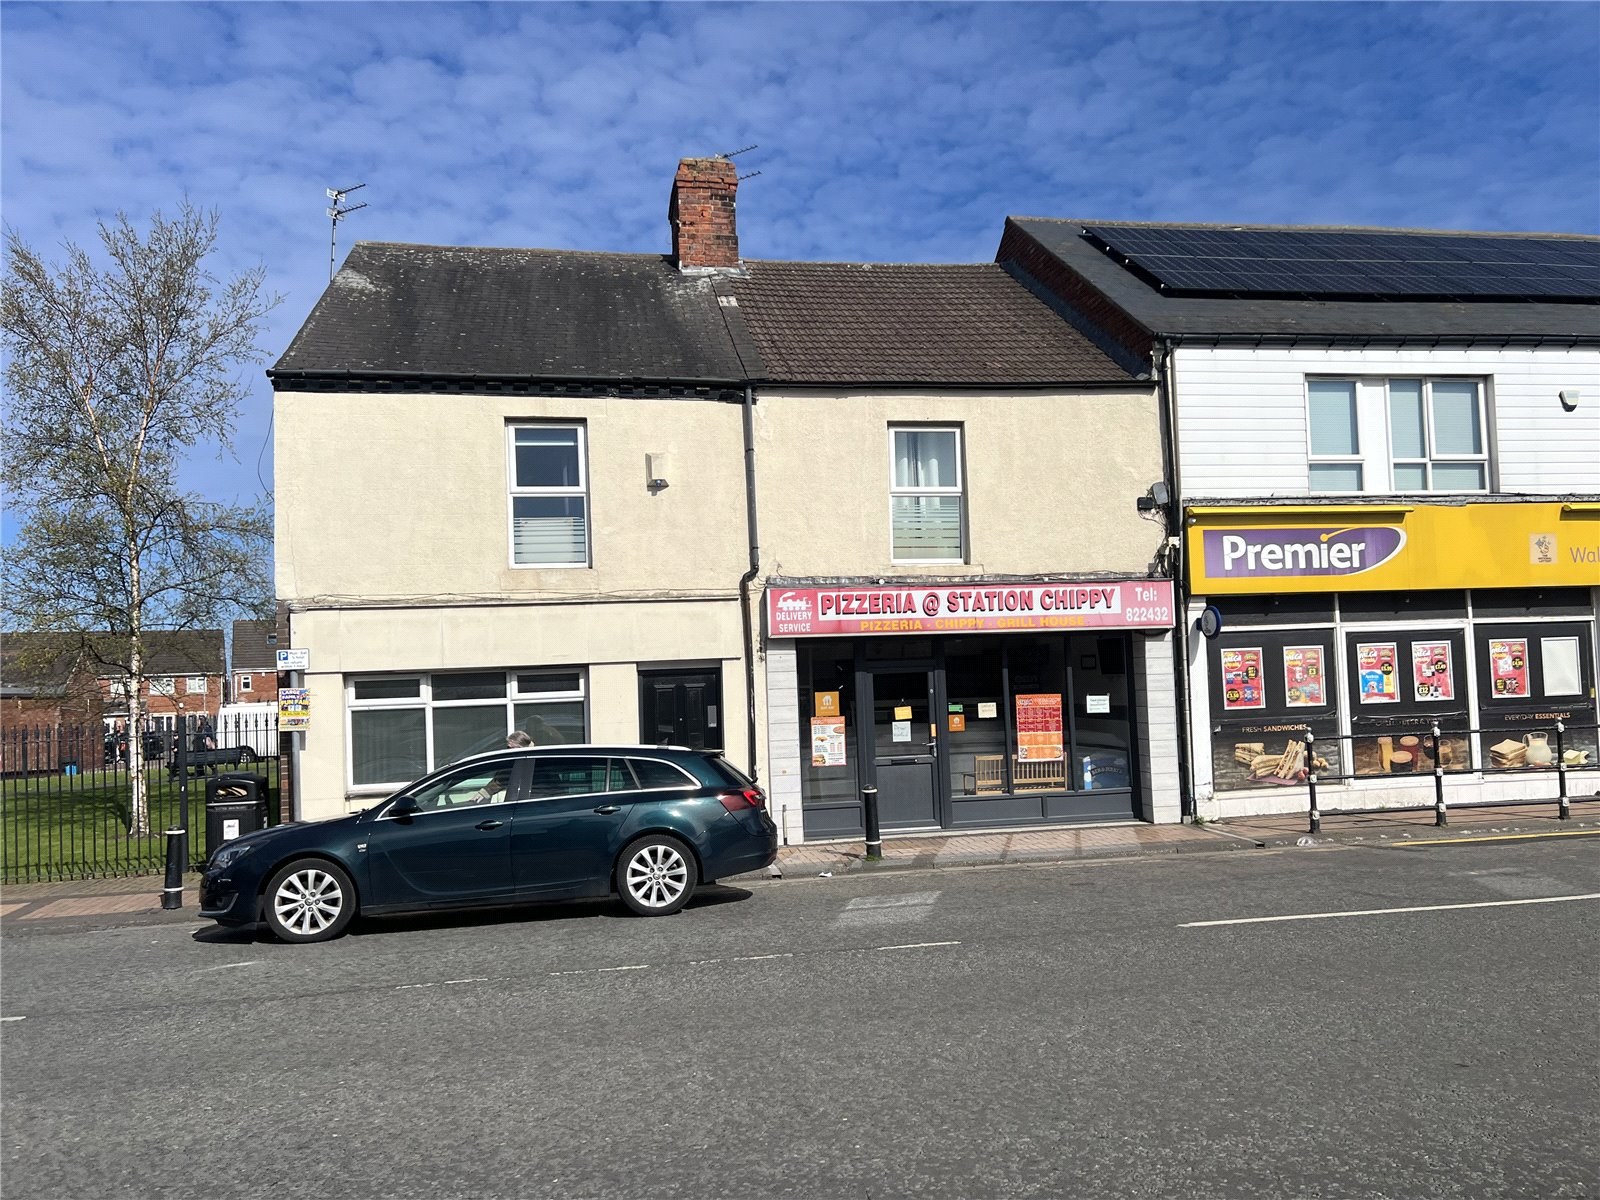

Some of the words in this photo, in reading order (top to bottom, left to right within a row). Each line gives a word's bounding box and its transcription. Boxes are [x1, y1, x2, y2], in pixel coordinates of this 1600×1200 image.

[1223, 534, 1366, 571] Premier
[821, 592, 916, 615] PIZZERIA
[923, 592, 941, 616] @
[947, 589, 1034, 612] STATION
[1040, 588, 1116, 610] CHIPPY
[1135, 587, 1157, 602] Tel:
[776, 611, 813, 621] DELIVERY
[1126, 607, 1169, 622] 822432
[779, 622, 811, 633] SERVICE
[860, 620, 923, 632] PIZZERIA
[935, 618, 984, 630] CHIPPY
[997, 617, 1036, 629] GRILL
[1040, 616, 1085, 628] HOUSE
[1504, 713, 1534, 721] EVERYDAY
[1535, 712, 1571, 720] ESSENTIALS
[1242, 725, 1262, 733] FRESH
[1263, 723, 1307, 732] SANDWICHES
